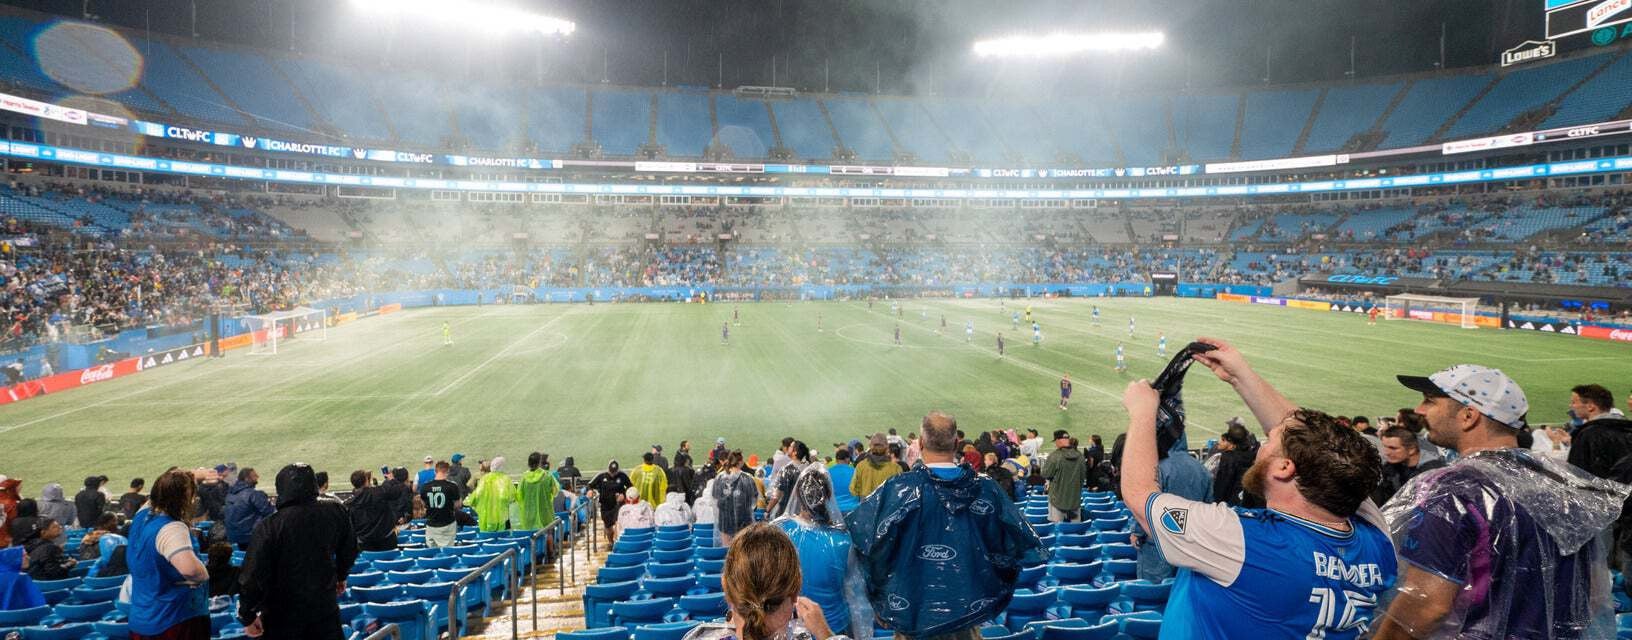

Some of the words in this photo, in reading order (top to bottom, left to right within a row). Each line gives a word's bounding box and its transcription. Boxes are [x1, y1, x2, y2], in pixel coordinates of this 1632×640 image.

[271, 140, 327, 155] CHARLOTTE
[427, 492, 446, 509] 10
[922, 546, 950, 559] Ford
